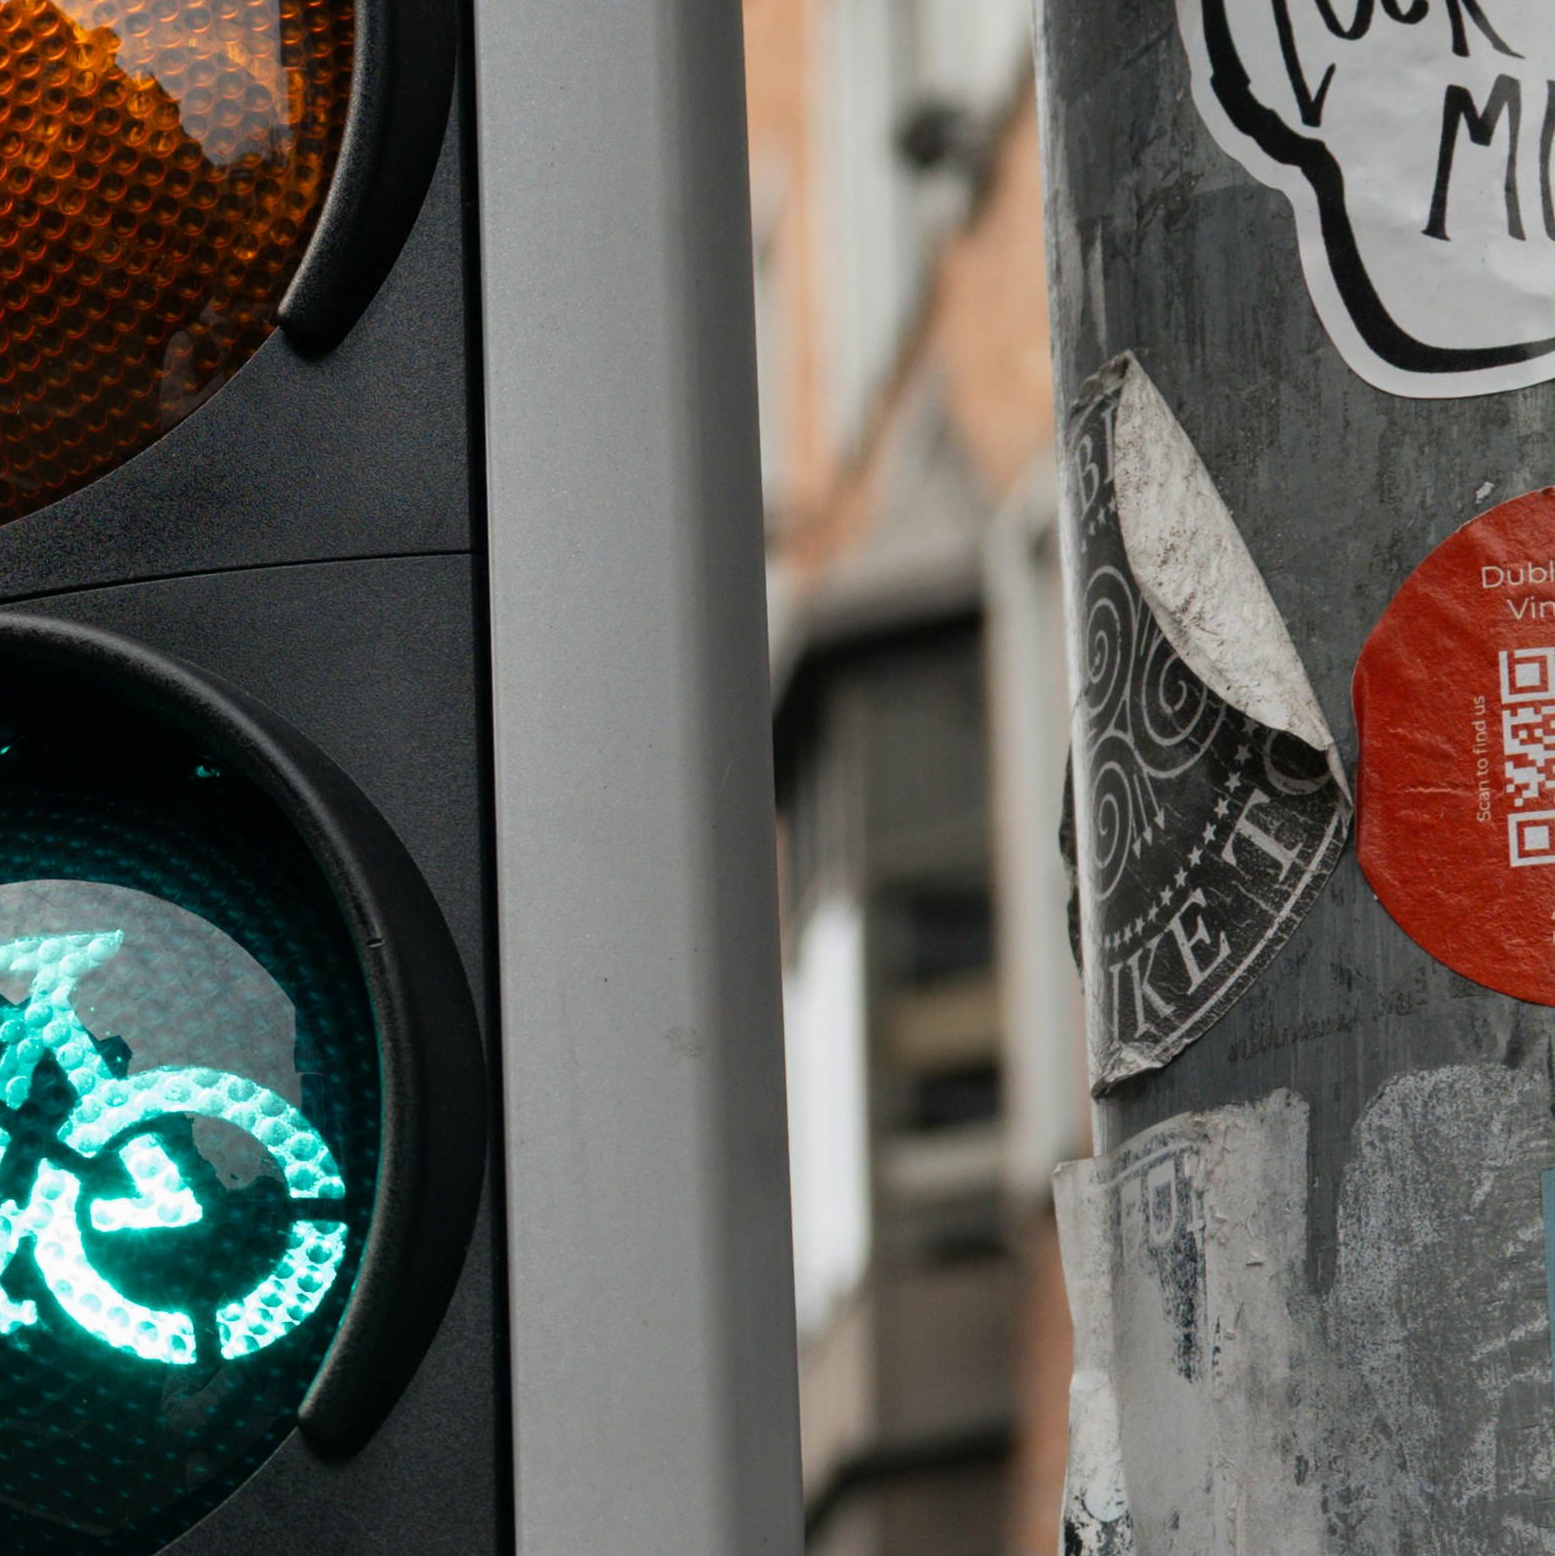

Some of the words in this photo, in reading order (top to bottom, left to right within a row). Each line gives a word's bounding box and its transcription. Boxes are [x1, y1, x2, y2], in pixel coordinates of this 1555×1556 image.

[1481, 559, 1555, 589] Dubl
[1473, 695, 1486, 717] us
[1472, 720, 1487, 755] find
[1476, 758, 1489, 776] to
[1477, 780, 1491, 822] Scan
